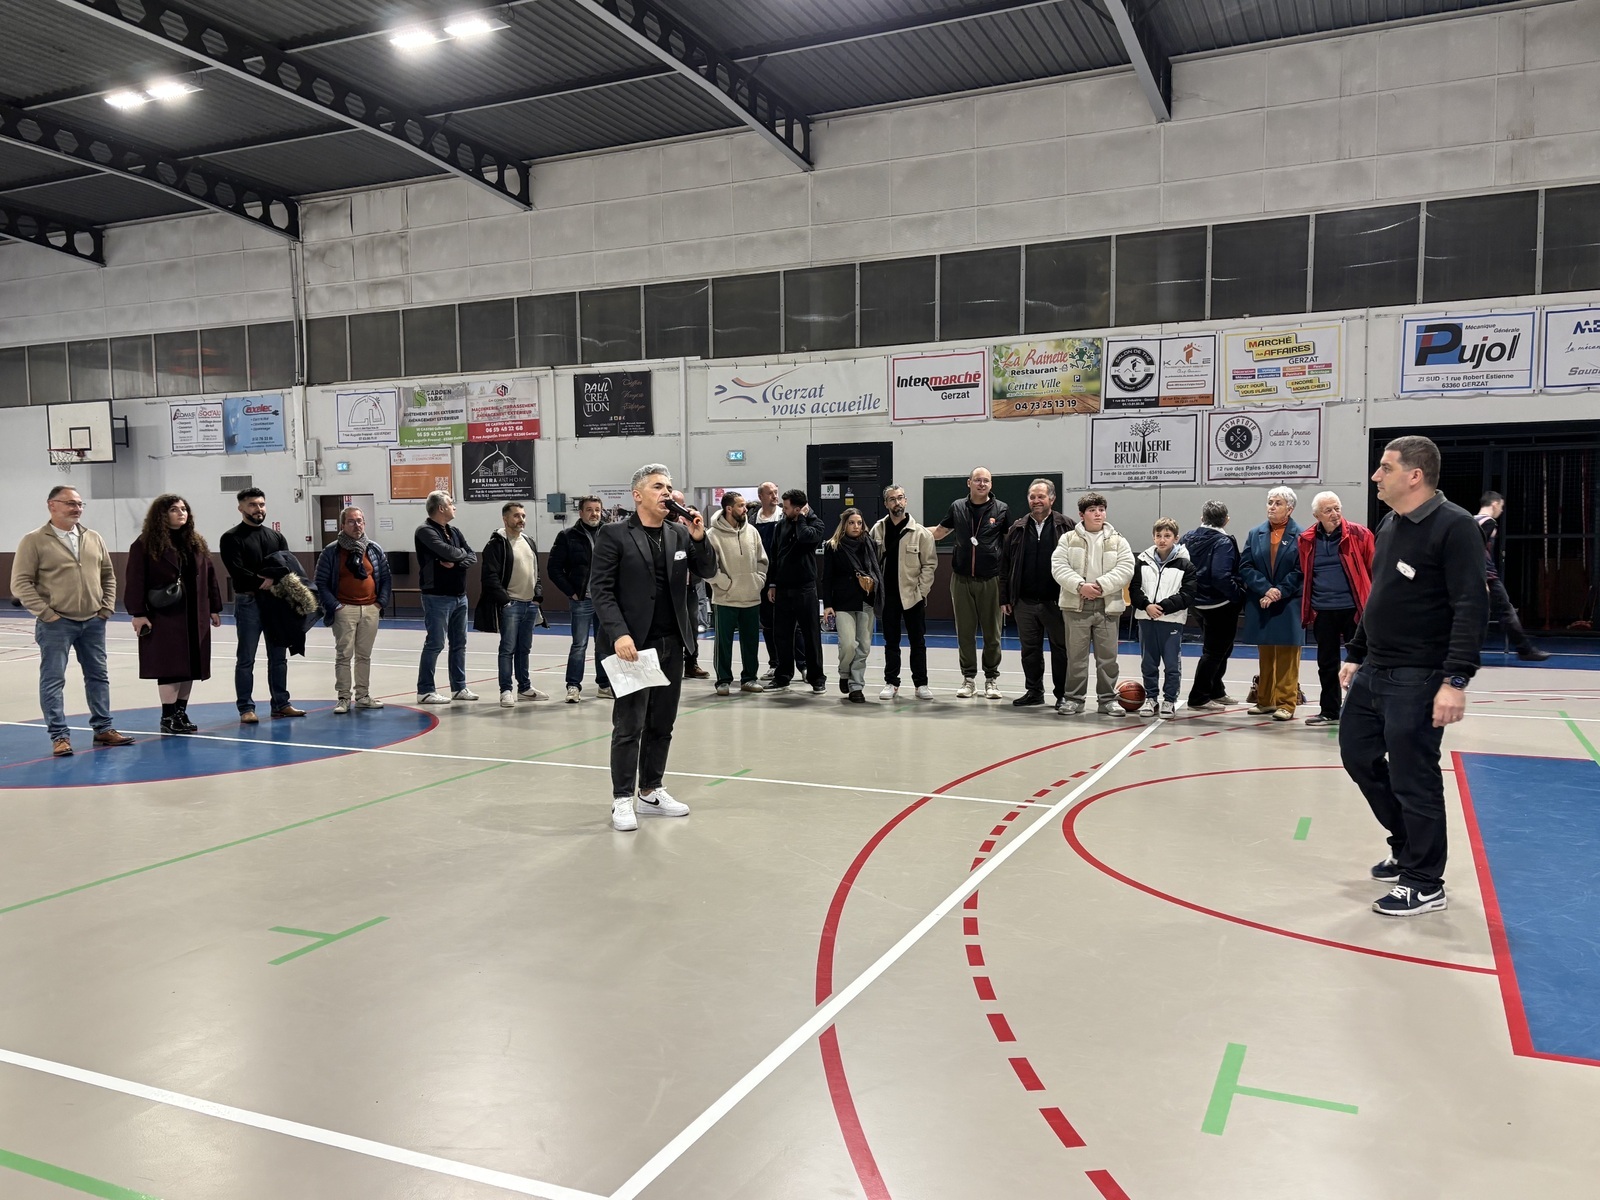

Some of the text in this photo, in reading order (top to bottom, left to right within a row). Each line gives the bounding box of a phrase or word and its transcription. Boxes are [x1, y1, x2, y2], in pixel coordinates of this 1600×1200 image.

[1248, 336, 1292, 348] MARCHÉ
[1415, 323, 1521, 369] Pujol
[1264, 345, 1310, 356] AFFAIRES
[1001, 349, 1068, 368] La Rainette
[1289, 356, 1319, 364] GERZAT
[1011, 366, 1058, 376] Restaurant
[584, 382, 608, 393] PAUL
[1007, 379, 1061, 391] Centre Ville
[584, 393, 609, 402] CREA
[772, 383, 824, 401] Gerzat
[940, 391, 970, 400] Gerzat
[586, 402, 610, 412] TION
[772, 393, 881, 416] vous accueille
[1015, 399, 1076, 410] 04 73 25 13 19
[1221, 418, 1257, 432] COMPTOIR
[1224, 448, 1253, 459] SPORTS
